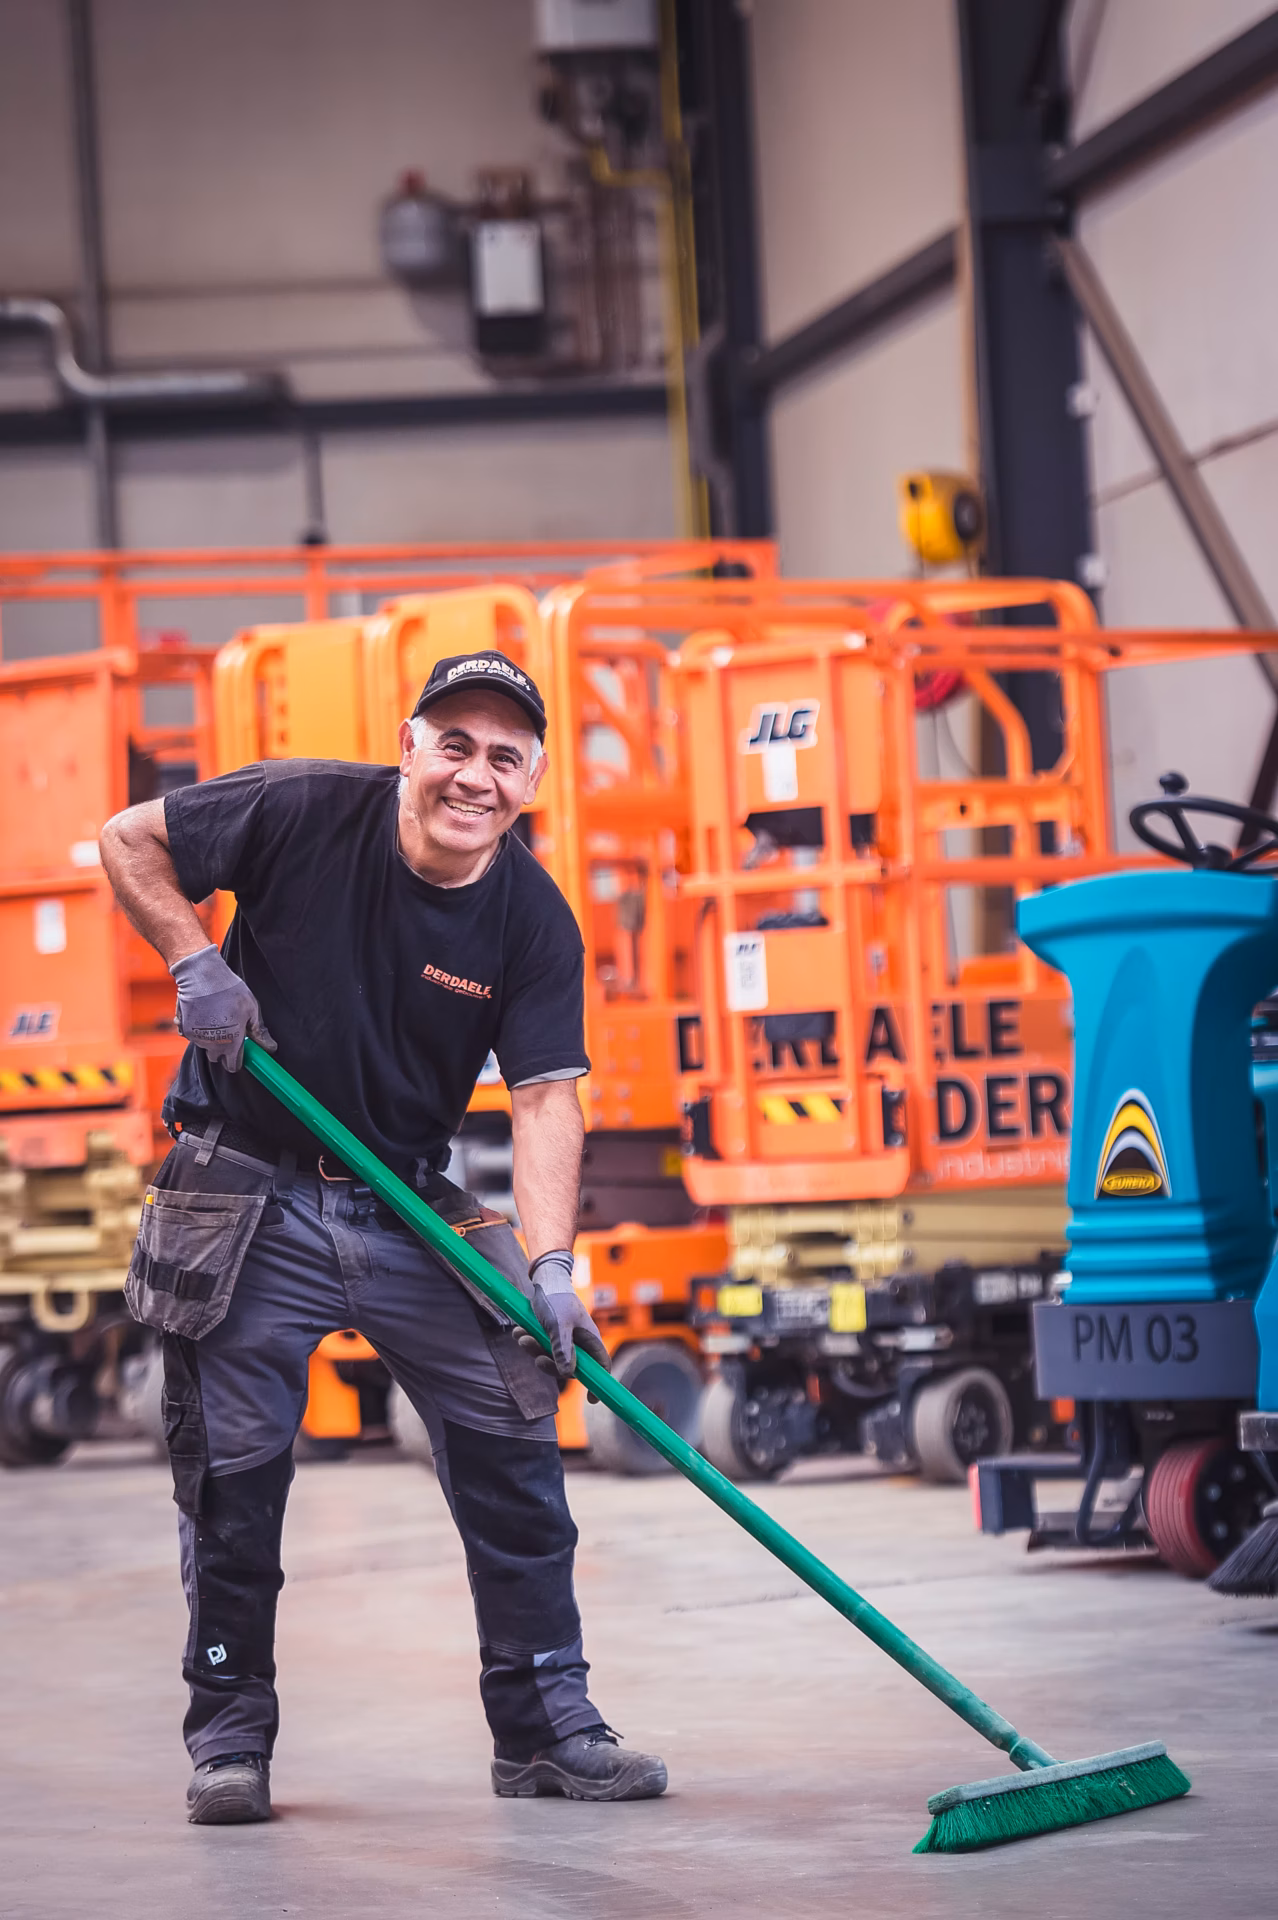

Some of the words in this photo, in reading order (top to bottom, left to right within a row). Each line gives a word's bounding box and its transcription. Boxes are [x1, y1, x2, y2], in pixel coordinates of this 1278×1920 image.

[446, 659, 528, 685] DERDAELE
[746, 706, 816, 747] JLG
[423, 963, 492, 996] DERDAELE
[938, 1148, 1070, 1181] industri
[1074, 1313, 1135, 1363] PM
[1145, 1313, 1199, 1364] 03
